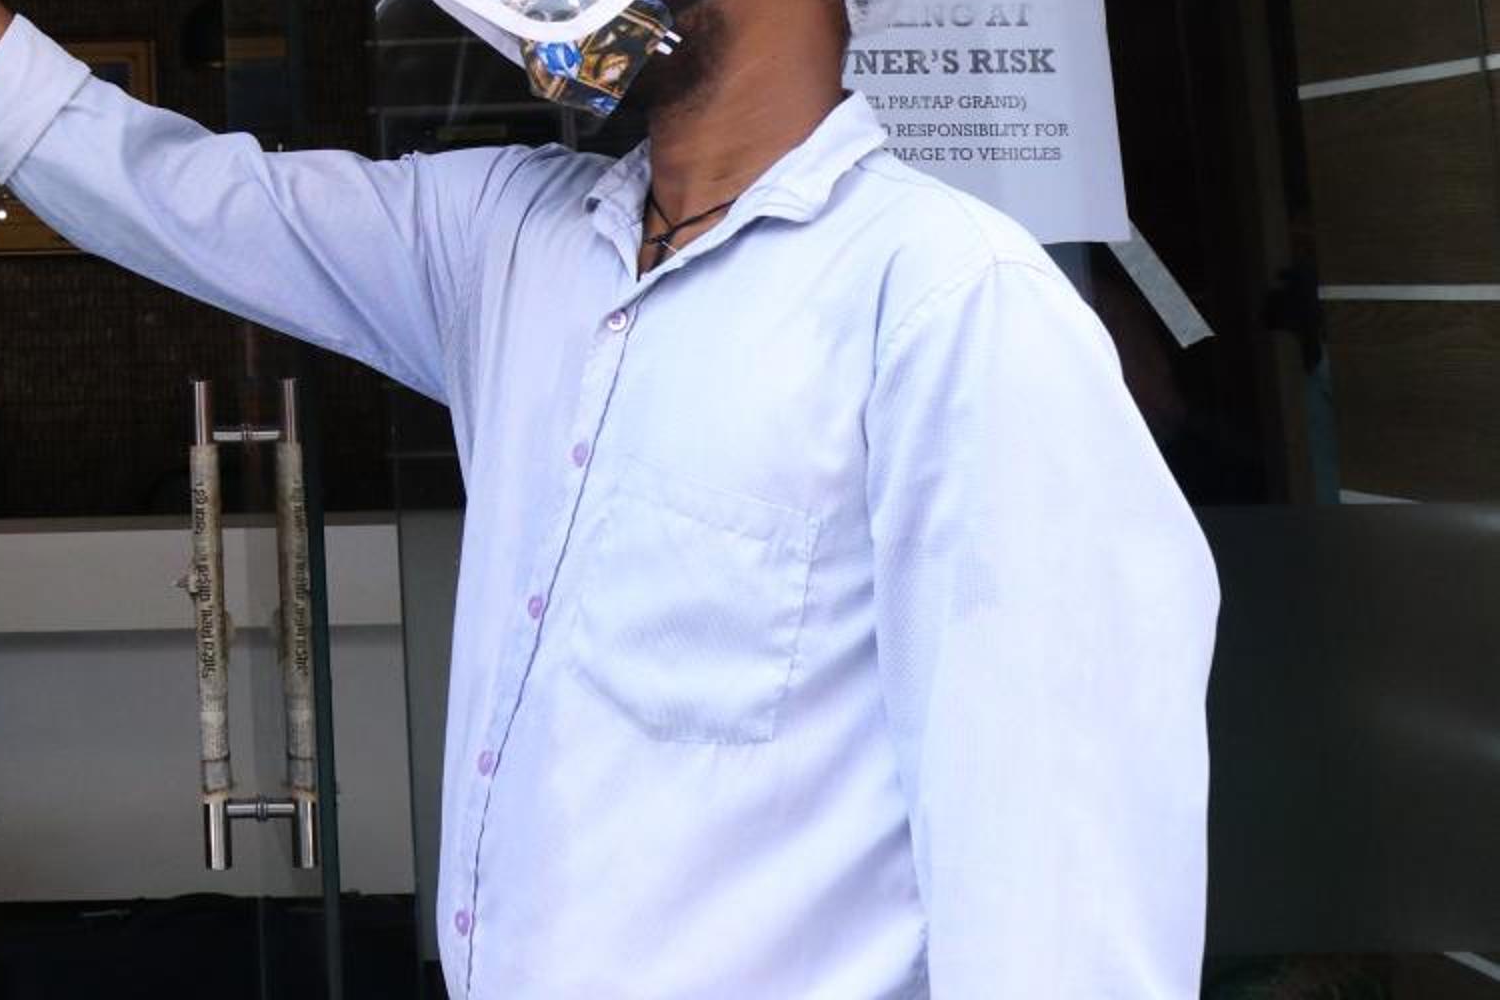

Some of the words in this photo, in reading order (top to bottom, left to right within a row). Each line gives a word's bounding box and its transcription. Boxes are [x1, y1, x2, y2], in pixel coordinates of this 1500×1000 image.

[985, 3, 1030, 27] AT
[968, 49, 1057, 74] RISK
[888, 96, 954, 110] PRATAP
[958, 95, 1028, 112] GRAND)
[896, 123, 1030, 137] RESPONSIBILITY
[1035, 123, 1070, 137] FOR
[951, 147, 974, 161] TO
[978, 147, 1062, 161] VEHICLES
